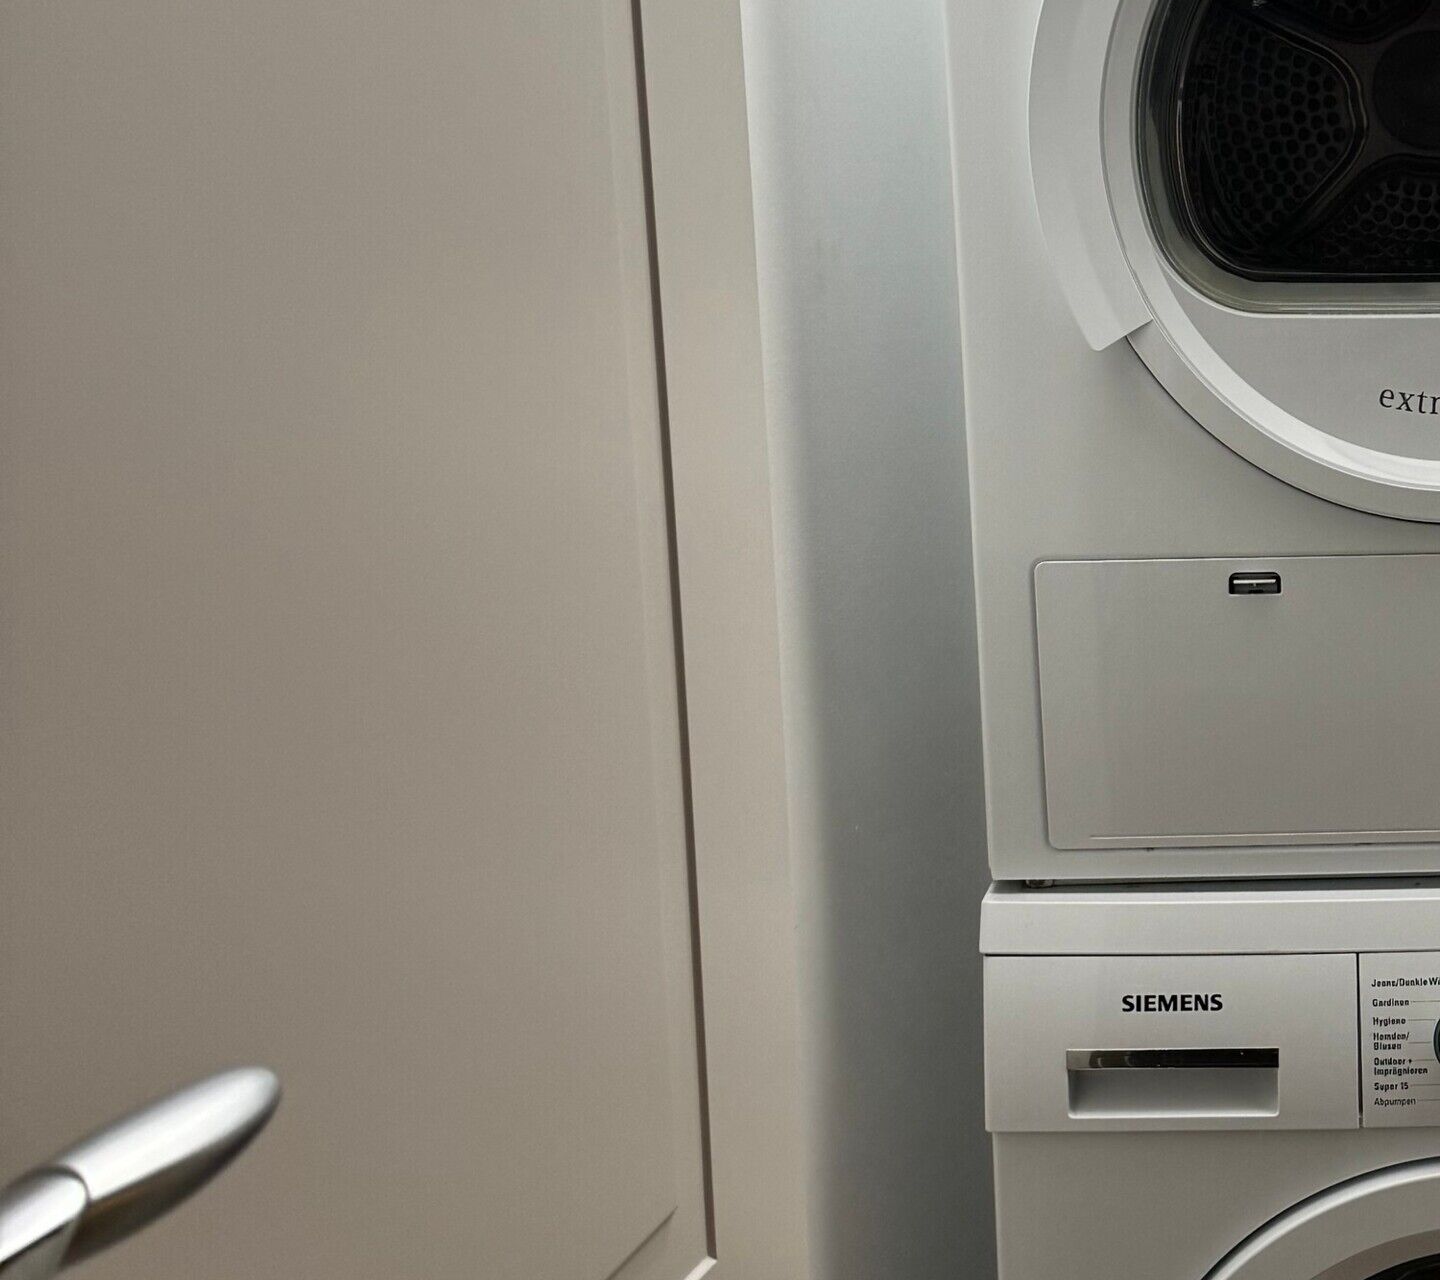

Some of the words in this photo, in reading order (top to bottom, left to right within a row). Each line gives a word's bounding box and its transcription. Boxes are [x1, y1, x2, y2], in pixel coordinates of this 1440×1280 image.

[1121, 993, 1223, 1013] SIEMENS
[1372, 999, 1410, 1008] Gardinen
[1374, 1083, 1399, 1092] Super
[1400, 1082, 1409, 1090] 15
[1374, 1097, 1416, 1107] Abpumpen
